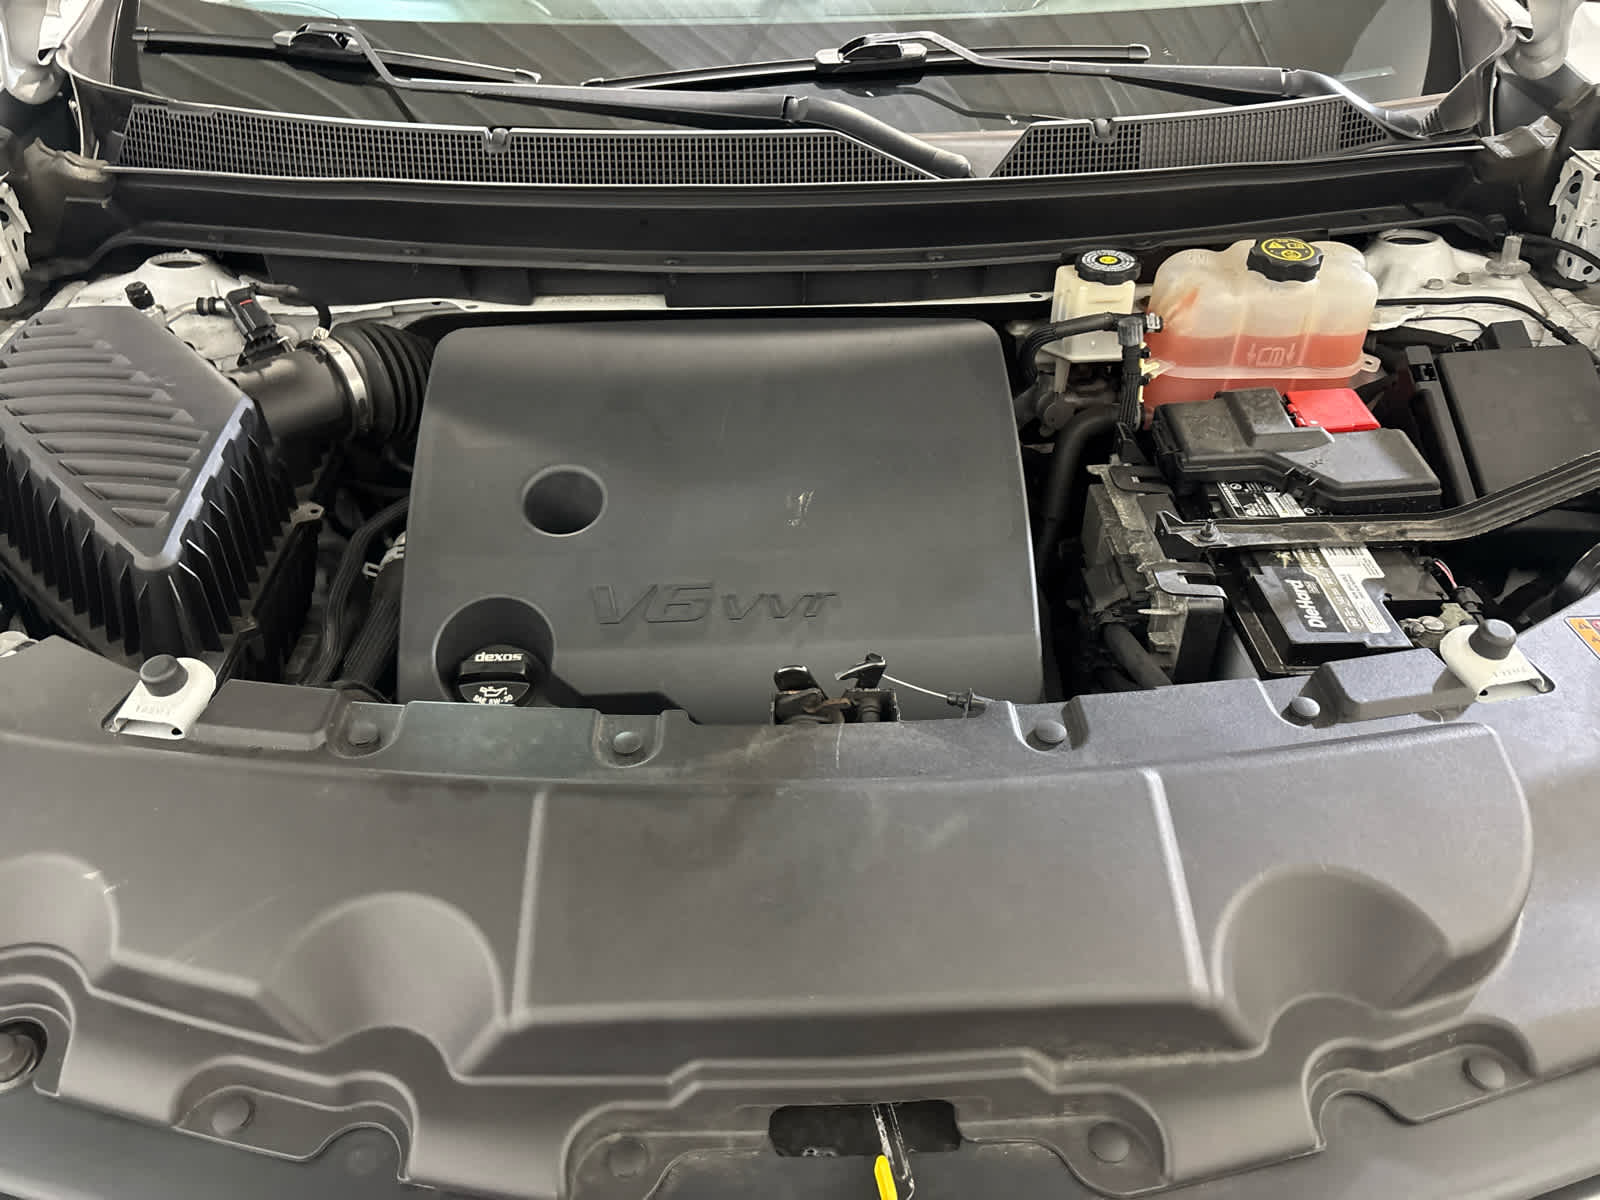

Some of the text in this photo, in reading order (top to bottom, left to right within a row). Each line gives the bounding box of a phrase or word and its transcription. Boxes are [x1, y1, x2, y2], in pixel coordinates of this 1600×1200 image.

[588, 583, 713, 625] V6
[1285, 579, 1327, 628] DieHard
[474, 651, 524, 662] dexos
